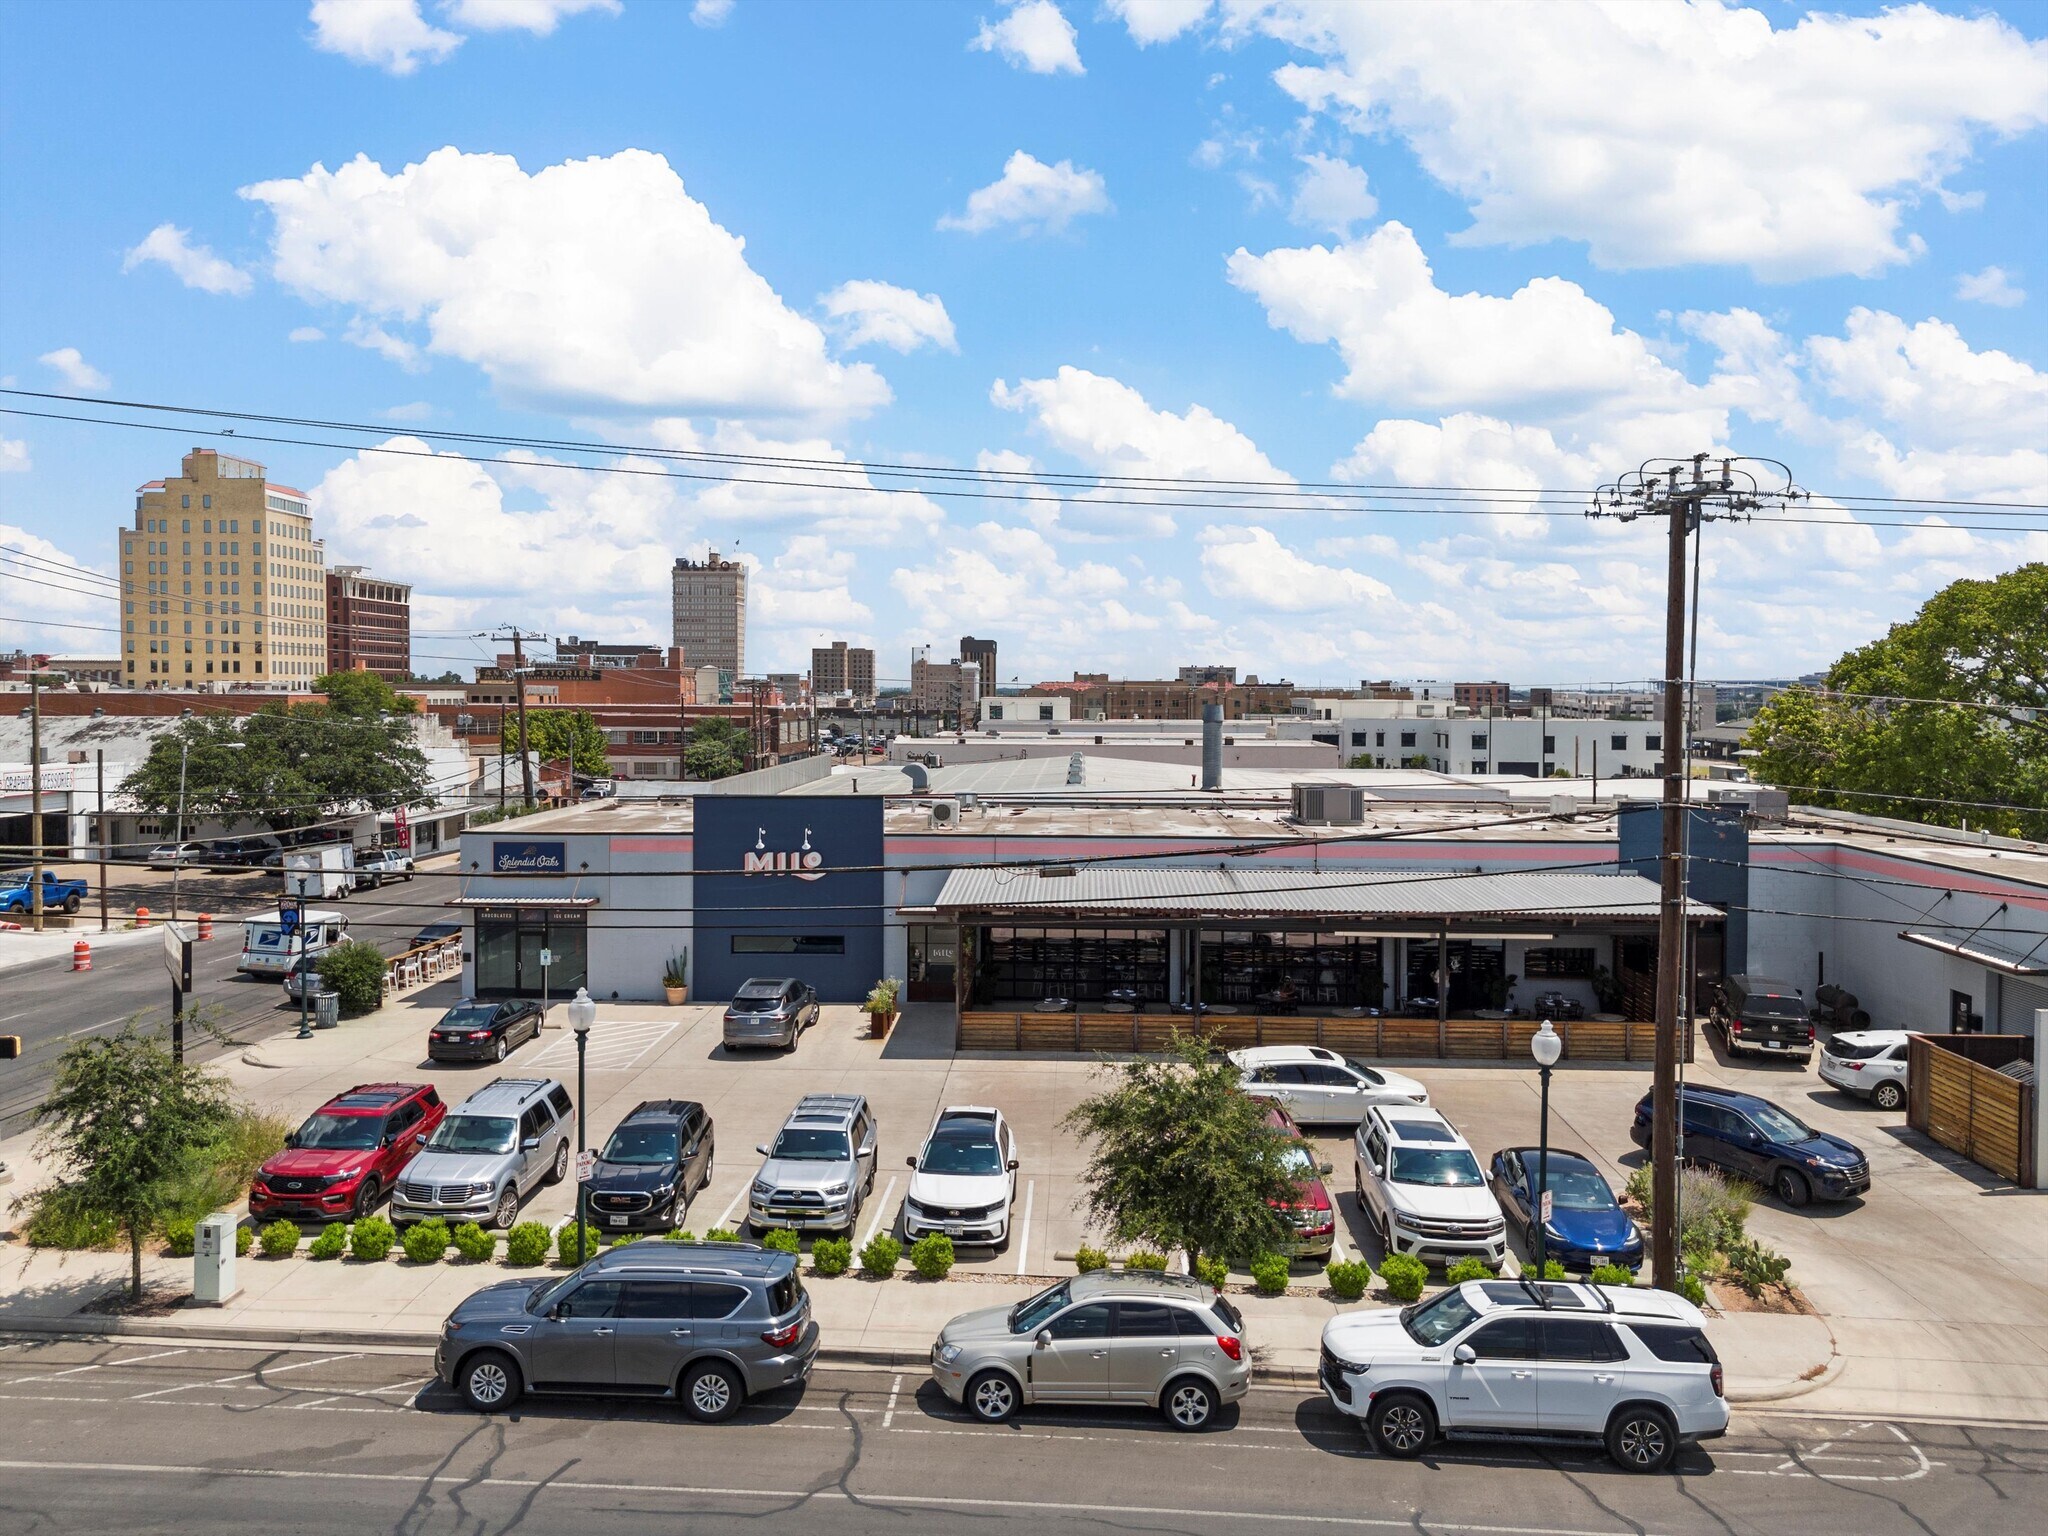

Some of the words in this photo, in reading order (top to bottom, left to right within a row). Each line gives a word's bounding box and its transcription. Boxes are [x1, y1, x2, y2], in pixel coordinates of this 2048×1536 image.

[498, 855, 536, 870] Splendid
[537, 855, 560, 867] Oaks
[576, 1160, 593, 1168] PARKING
